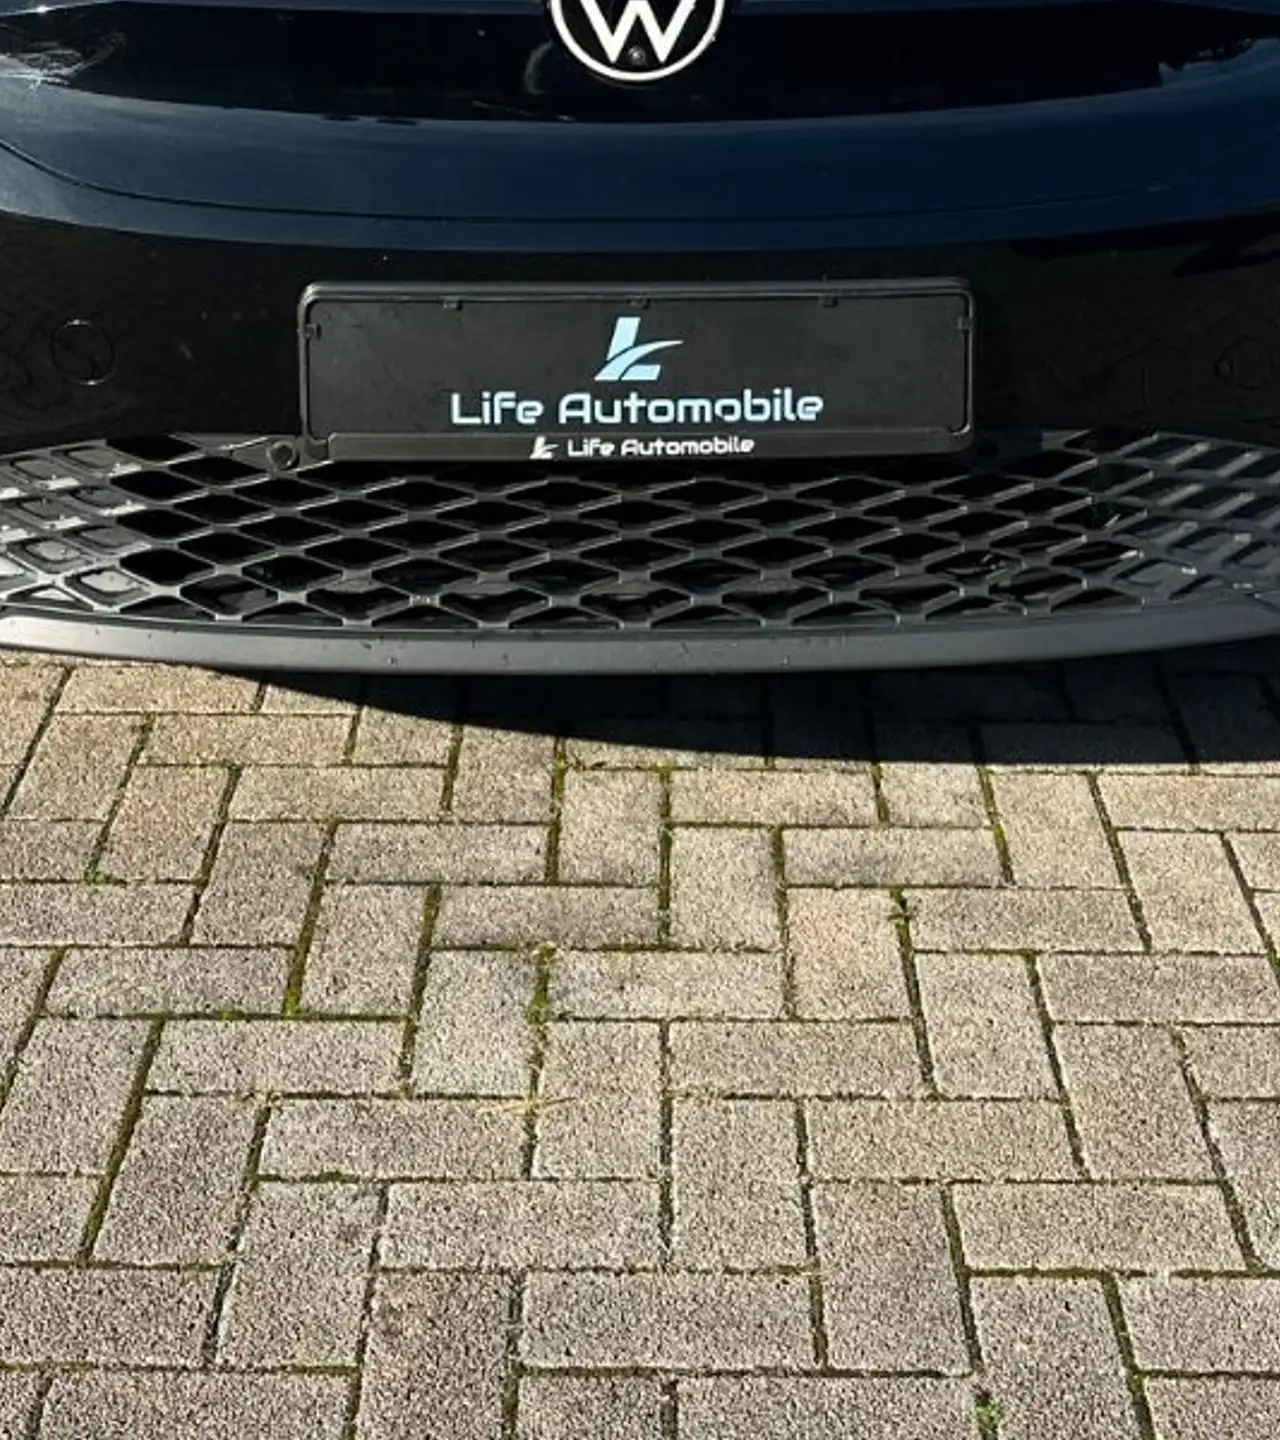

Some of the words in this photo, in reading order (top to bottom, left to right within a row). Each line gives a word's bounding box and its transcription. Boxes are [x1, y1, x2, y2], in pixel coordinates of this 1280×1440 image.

[450, 391, 544, 426] Life
[558, 387, 824, 425] Automobile
[567, 438, 615, 457] Life
[620, 436, 756, 457] Automobile
